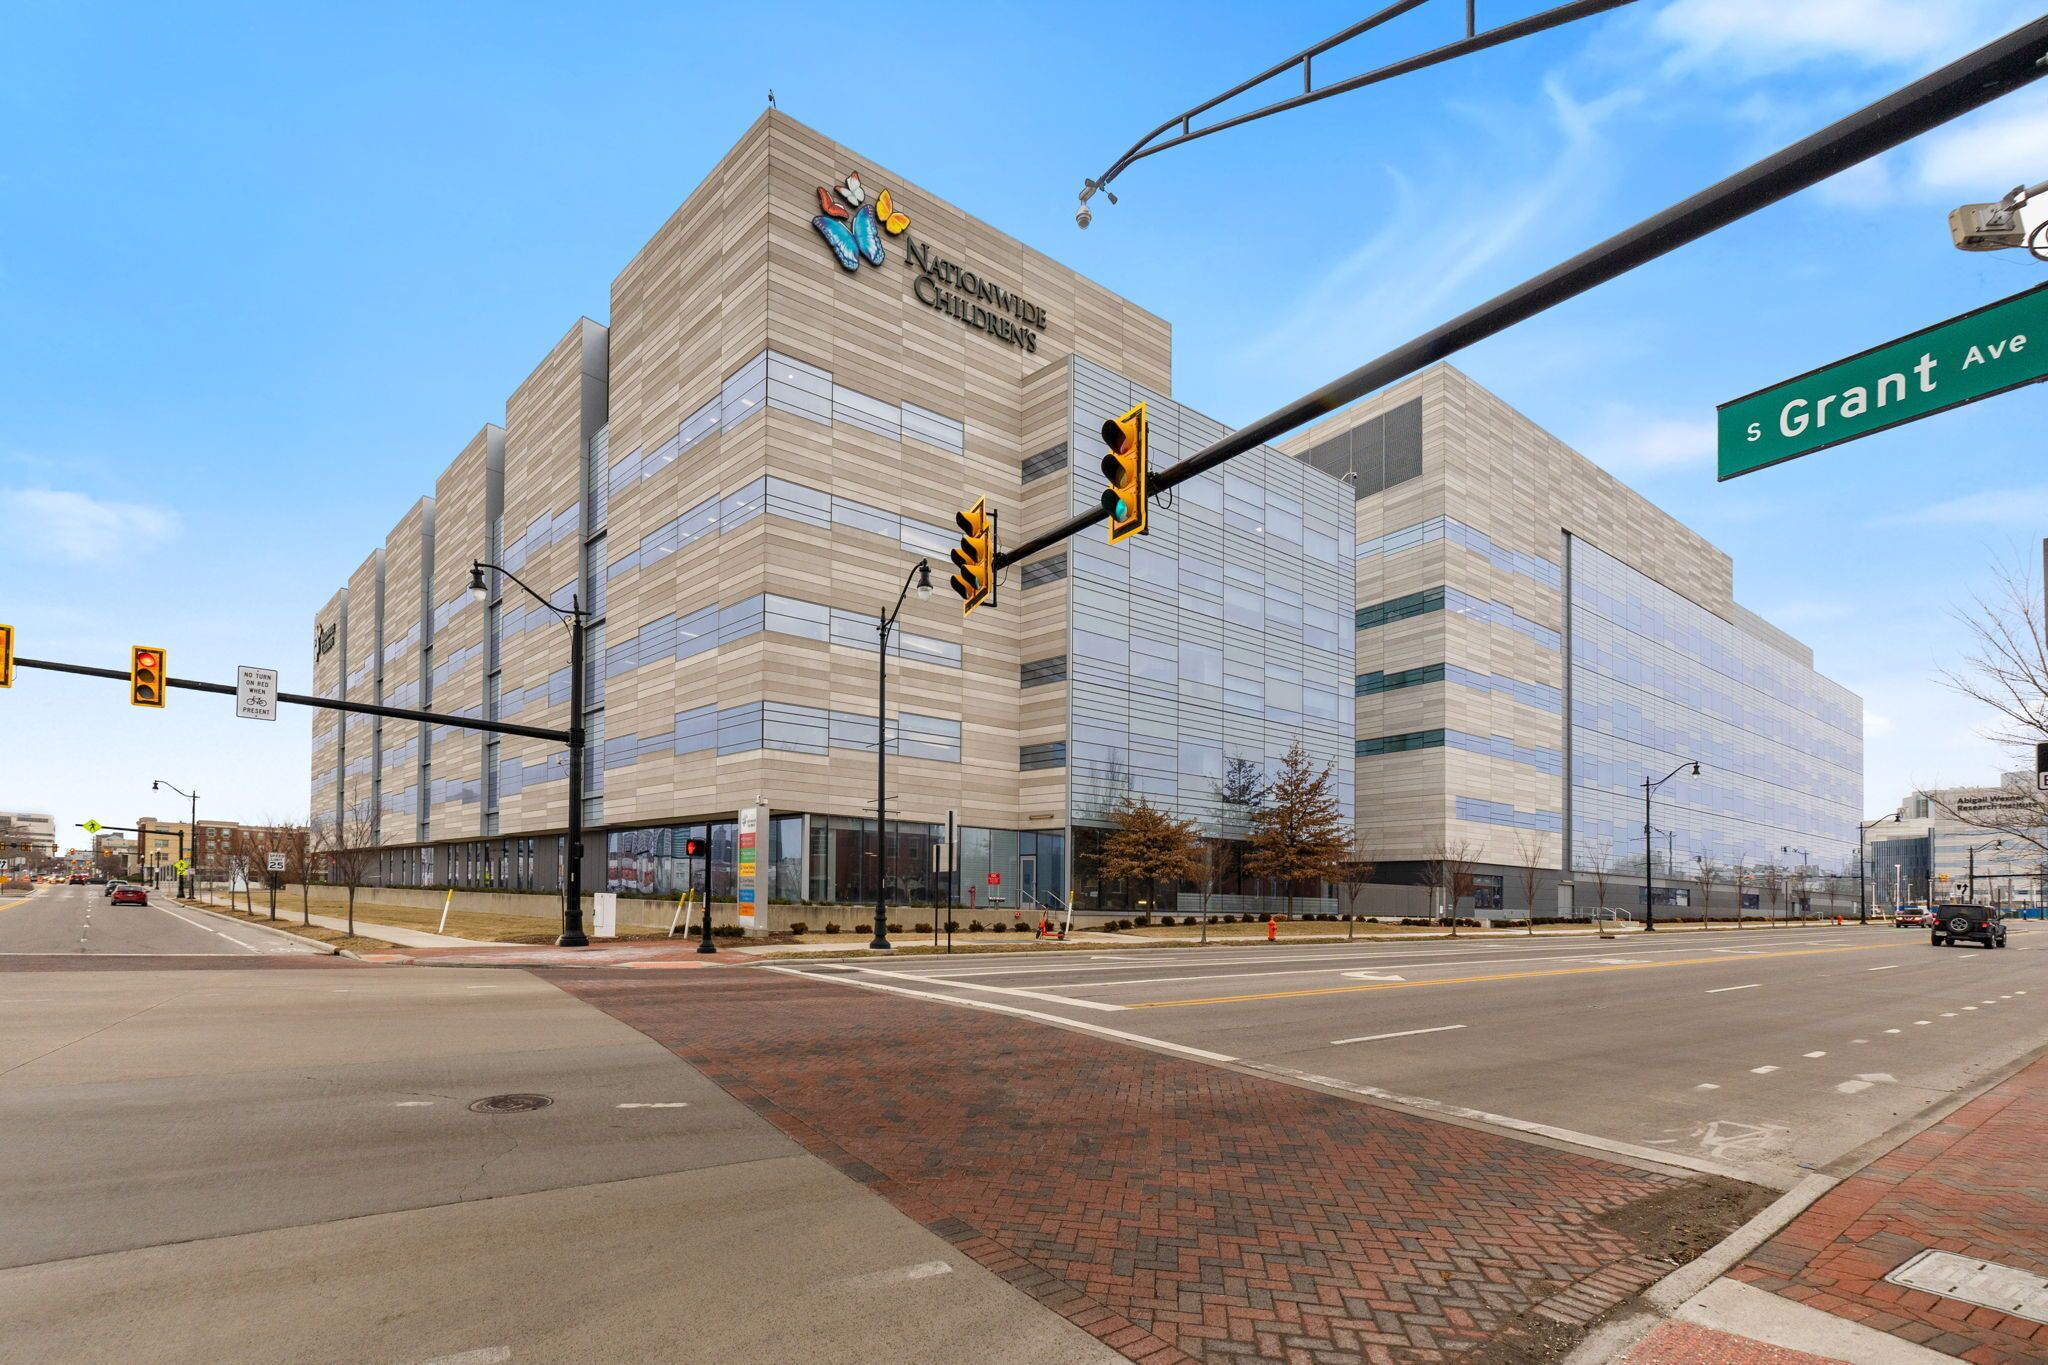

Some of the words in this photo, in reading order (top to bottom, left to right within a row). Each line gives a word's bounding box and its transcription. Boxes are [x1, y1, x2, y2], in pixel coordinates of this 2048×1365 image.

[904, 236, 1047, 330] NATIONWIDE
[913, 274, 1038, 353] CHILDREN'S
[1779, 353, 1938, 438] Grant
[1961, 334, 2027, 370] Ave
[243, 707, 270, 715] PRESENT
[1957, 796, 1988, 804] Abigail
[1957, 803, 1997, 811] Research
[1999, 802, 2038, 810] Institute
[269, 861, 284, 869] 25
